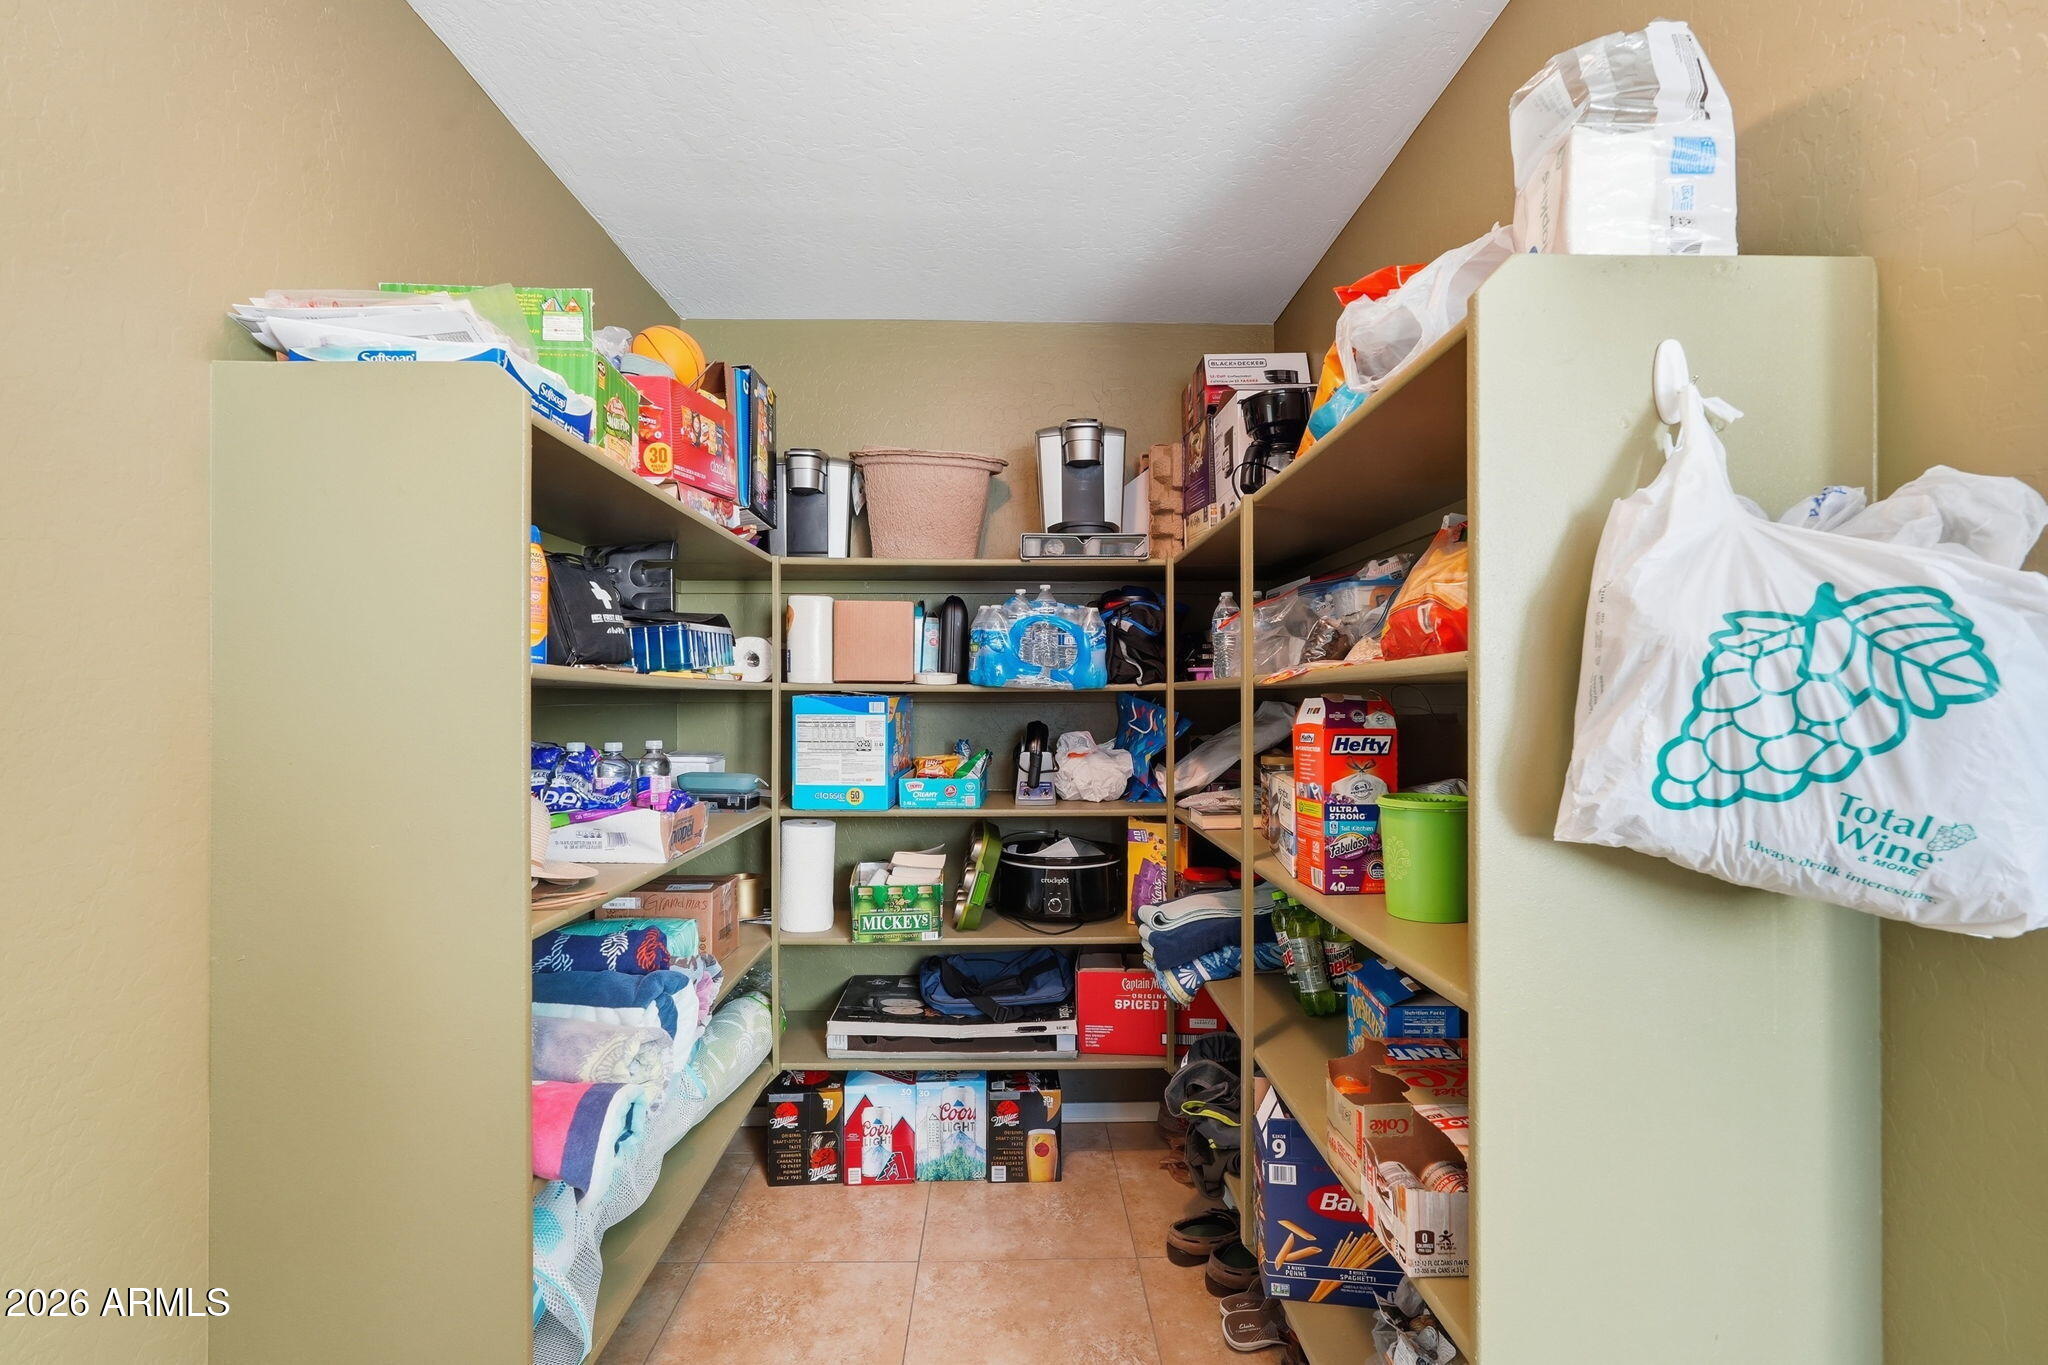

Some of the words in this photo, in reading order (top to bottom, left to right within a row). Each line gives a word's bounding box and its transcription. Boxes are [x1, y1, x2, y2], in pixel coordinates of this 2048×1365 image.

[649, 447, 667, 463] 30
[1334, 737, 1388, 753] Hefty
[1840, 792, 1934, 840] Total
[1330, 838, 1368, 858] Fabuloso
[1838, 820, 1934, 870] Wine
[1744, 840, 1794, 864] Always
[1798, 858, 1841, 876] drink
[1873, 859, 1921, 877] MORE
[1330, 882, 1345, 892] 40
[1121, 977, 1150, 992] Captain
[1114, 999, 1159, 1011] SPICED
[1387, 1047, 1461, 1061] FANT
[942, 1121, 975, 1132] LIGHT
[1369, 1118, 1409, 1135] Coke
[864, 1136, 891, 1147] LIGHT
[1319, 1192, 1364, 1213] Bar
[1421, 1232, 1428, 1243] 0
[1340, 1274, 1377, 1283] SPAGHETTI
